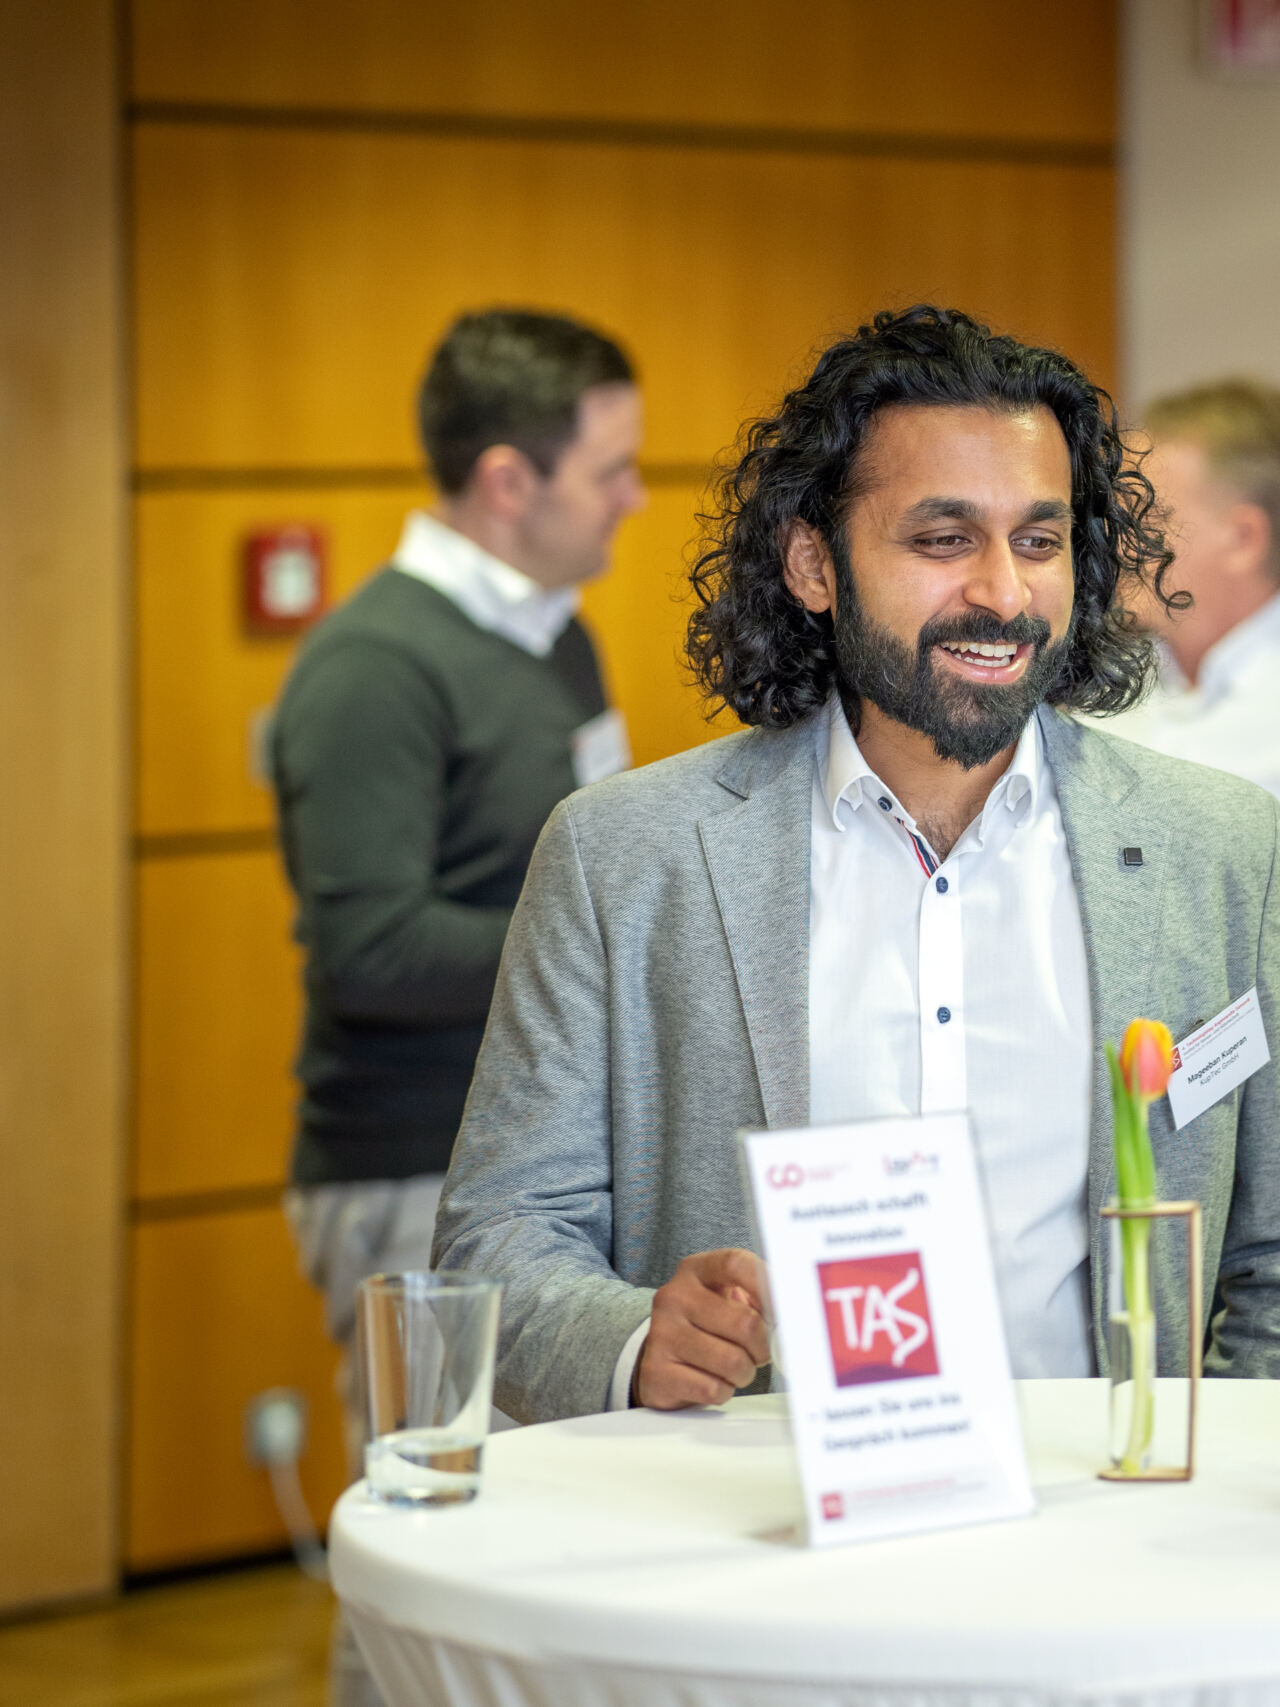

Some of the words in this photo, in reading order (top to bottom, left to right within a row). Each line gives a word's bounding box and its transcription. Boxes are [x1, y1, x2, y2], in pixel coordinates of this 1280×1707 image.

[1187, 1056, 1220, 1084] Mageeban
[1221, 1036, 1247, 1059] Kuperan
[1222, 1053, 1239, 1070] GmbH
[825, 1267, 929, 1368] TAS
[879, 1397, 902, 1413] Sie
